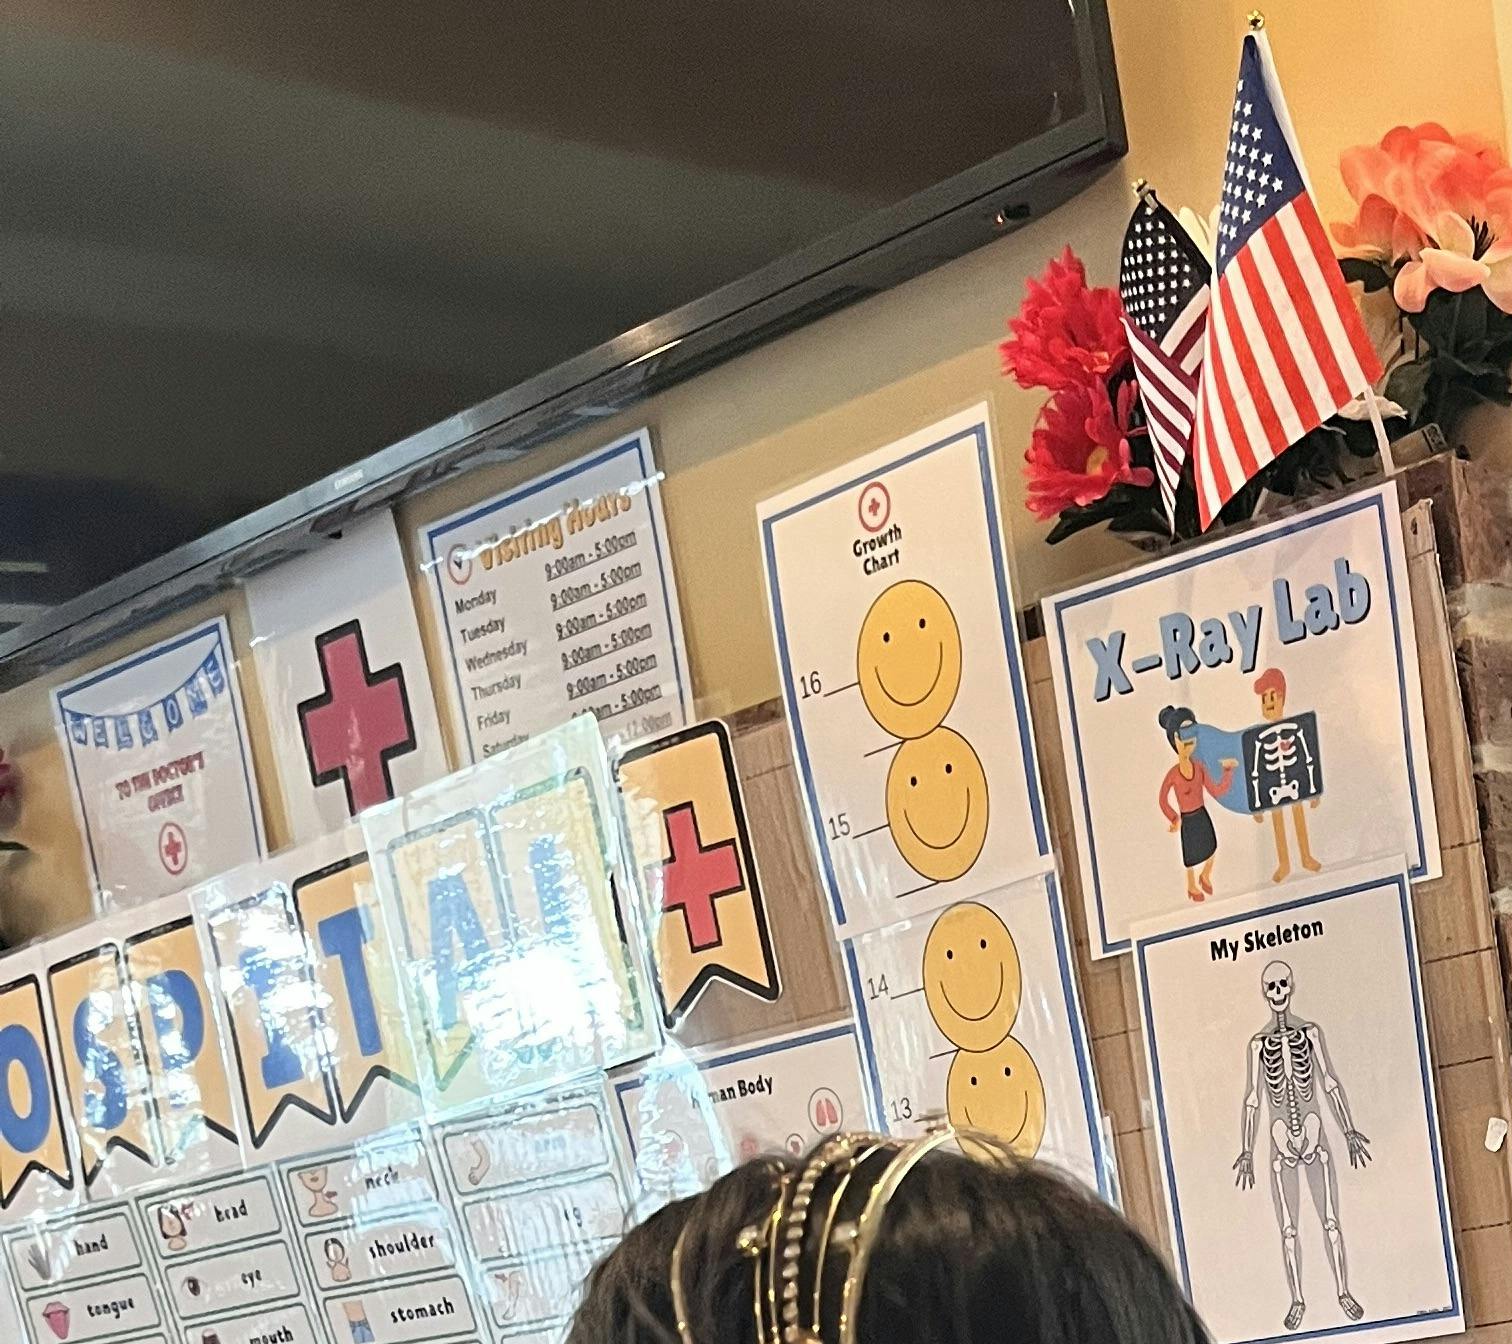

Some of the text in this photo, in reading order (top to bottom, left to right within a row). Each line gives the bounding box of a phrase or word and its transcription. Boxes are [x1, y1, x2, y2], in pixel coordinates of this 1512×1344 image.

[853, 523, 902, 557] Growth
[455, 587, 497, 614] Monday
[594, 531, 637, 557] 5:00pm
[863, 548, 900, 576] Chart
[460, 616, 506, 644] Tuesday
[600, 562, 642, 589] 5:00pm
[465, 638, 527, 673] Wednesday
[605, 592, 647, 619] 5:00pm
[1087, 557, 1372, 702] X-Ray Lab
[471, 672, 521, 700] Thursday
[610, 622, 653, 650] 5:00pm
[477, 708, 511, 731] Friday
[616, 653, 657, 680] 5:00pm
[800, 672, 822, 700] 16
[828, 814, 851, 842] 15
[1210, 921, 1324, 961] My Skeleton
[868, 974, 890, 1001] 14
[737, 1075, 774, 1099] Body
[891, 1097, 913, 1123] 13
[74, 1233, 108, 1257] hand
[369, 1232, 434, 1260] shoulder
[241, 1268, 262, 1288] eye
[87, 1297, 135, 1320] tongue
[390, 1296, 455, 1324] stomach
